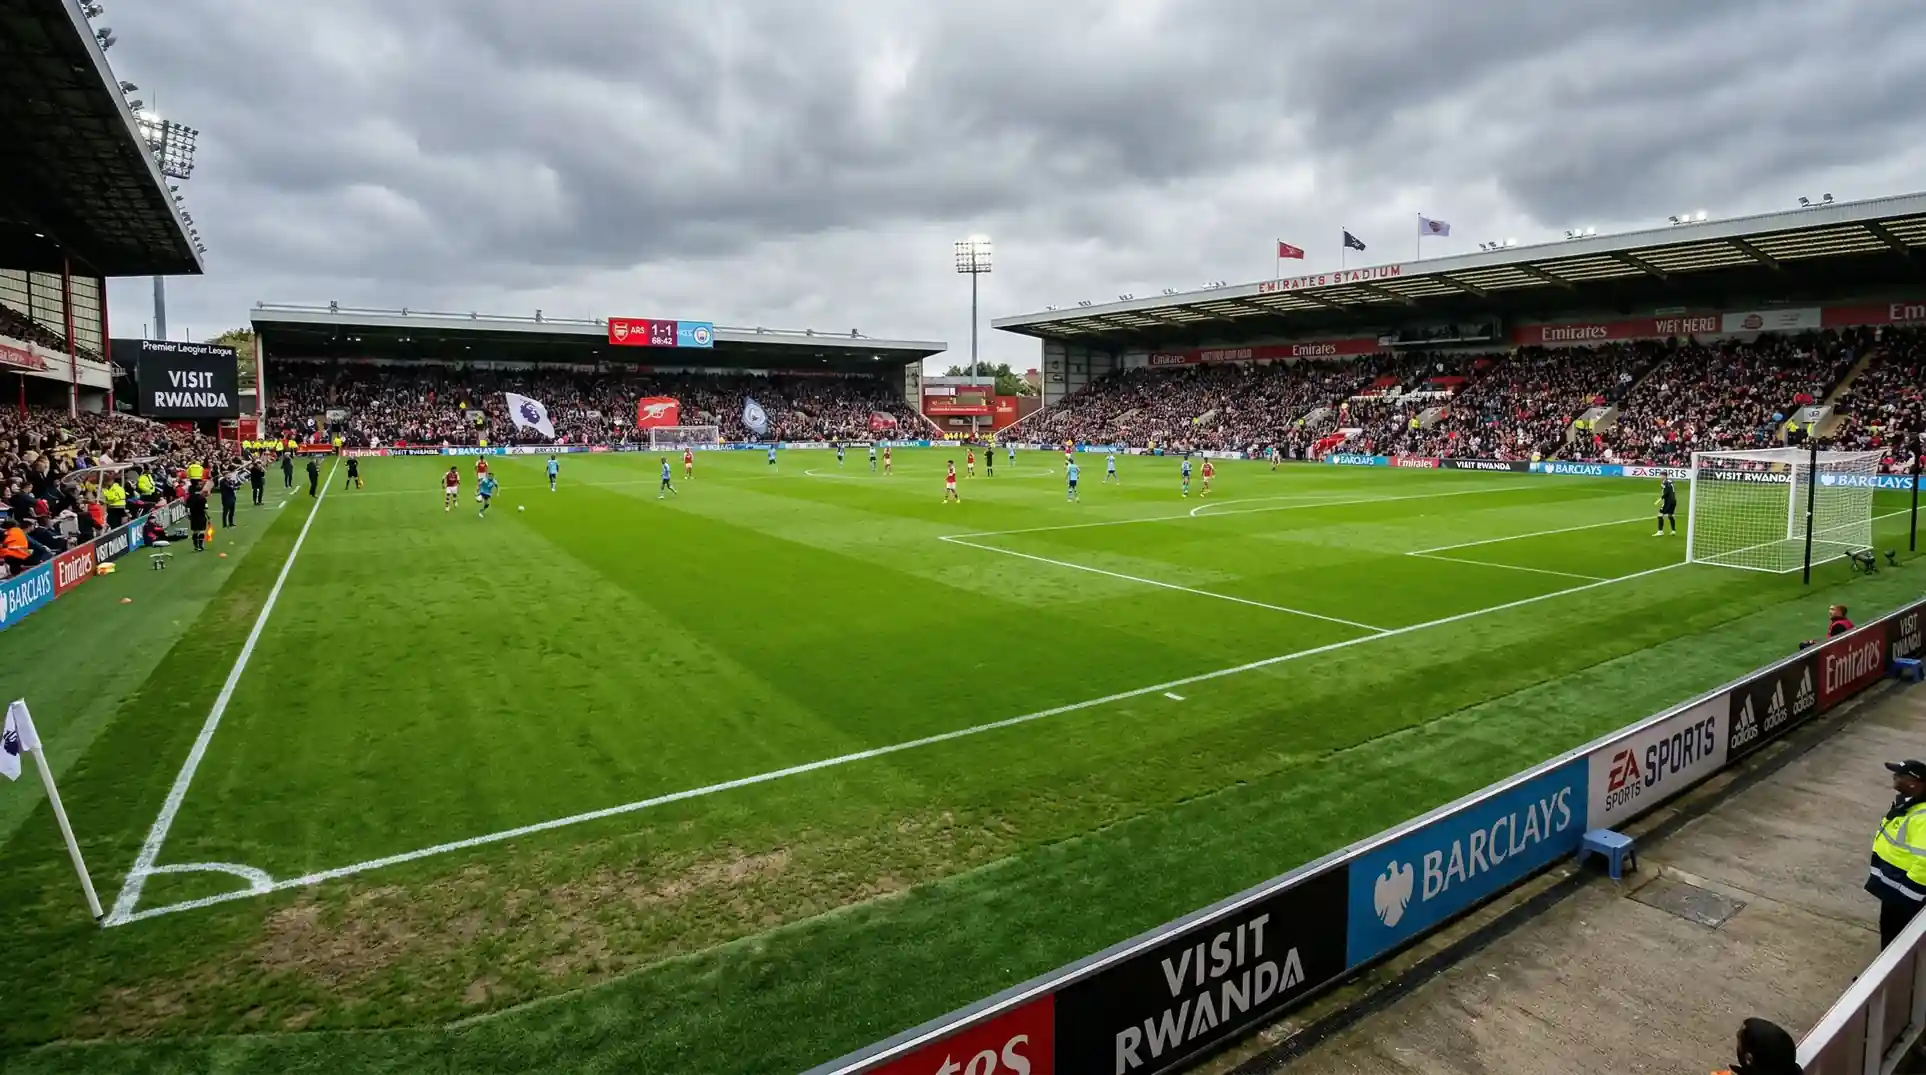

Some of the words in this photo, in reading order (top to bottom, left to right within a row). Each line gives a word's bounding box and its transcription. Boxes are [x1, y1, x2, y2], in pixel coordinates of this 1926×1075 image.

[1258, 275, 1326, 292] EMIRATES
[1333, 265, 1401, 284] STADIUM
[1541, 325, 1608, 341] Emirates
[1292, 343, 1336, 356] Emirates
[167, 370, 214, 389] VISIT
[154, 391, 229, 408] RWANDA
[1555, 465, 1602, 476] BARCLAYS
[1648, 468, 1687, 479] SPRTS
[1715, 471, 1742, 480] VISIT
[1837, 475, 1914, 489] BARCLAYS
[58, 551, 93, 588] Emirates
[9, 571, 51, 613] BARCLAYS
[1826, 639, 1880, 695] Emirates
[1792, 691, 1816, 716] adidas
[1763, 706, 1788, 732] adidas
[1731, 722, 1760, 749] adidas
[1607, 748, 1641, 794] EA
[1644, 715, 1715, 788] SPORTS
[1605, 780, 1641, 812] SPORTS
[1421, 786, 1572, 902] BARCLAYS
[1161, 913, 1270, 998] VISIT
[1115, 946, 1306, 1075] RWANDA
